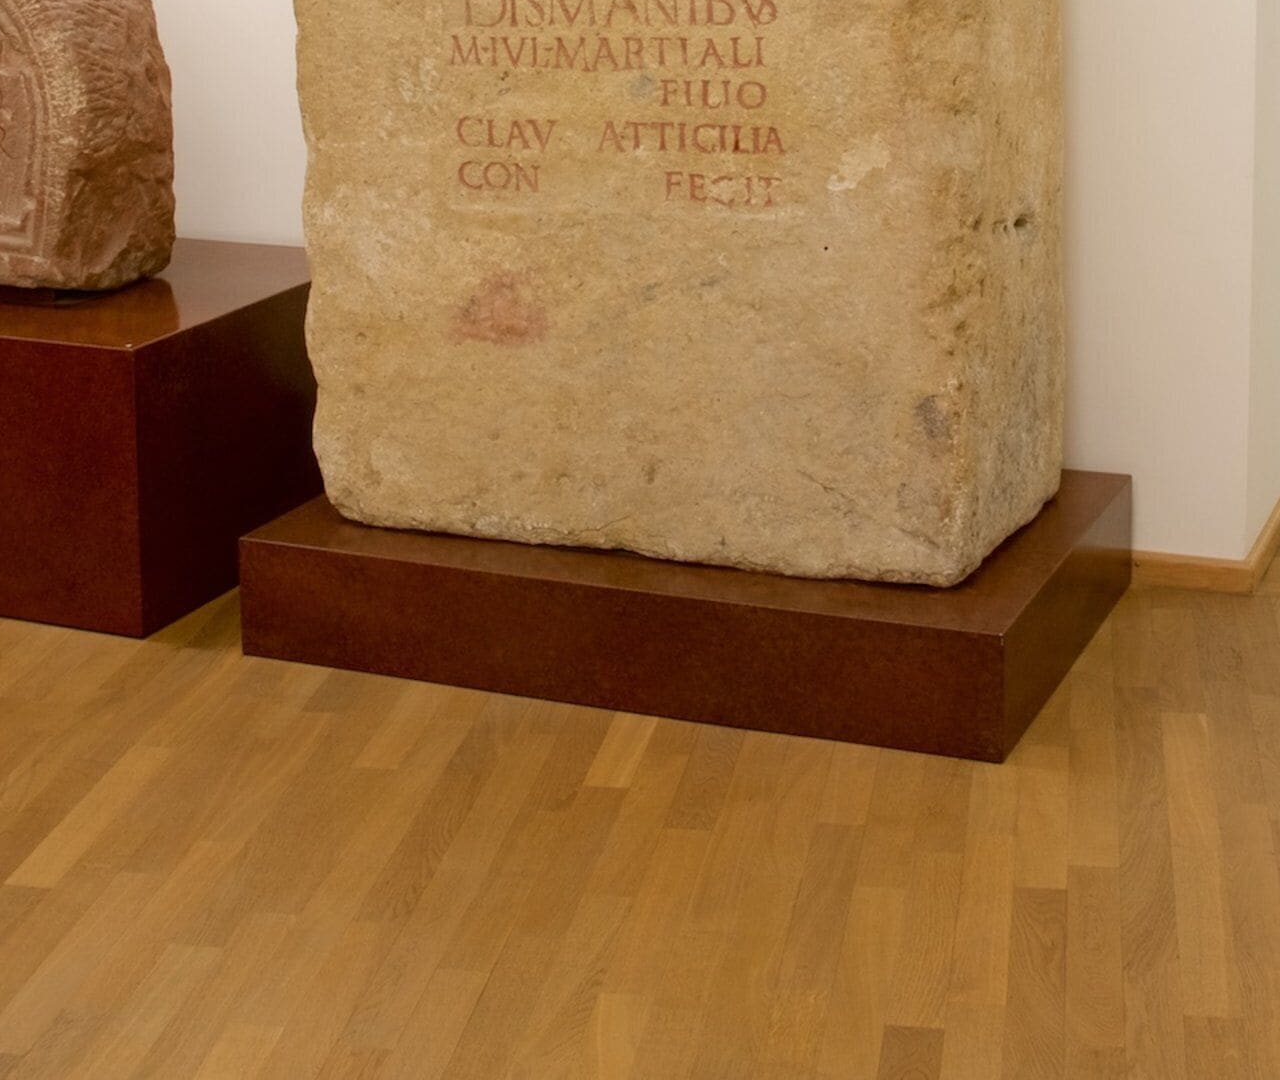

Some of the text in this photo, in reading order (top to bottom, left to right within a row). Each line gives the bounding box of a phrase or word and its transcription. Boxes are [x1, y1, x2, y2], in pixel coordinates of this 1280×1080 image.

[657, 78, 769, 111] FILIO
[455, 116, 556, 151] CLAV
[457, 159, 543, 194] CON
